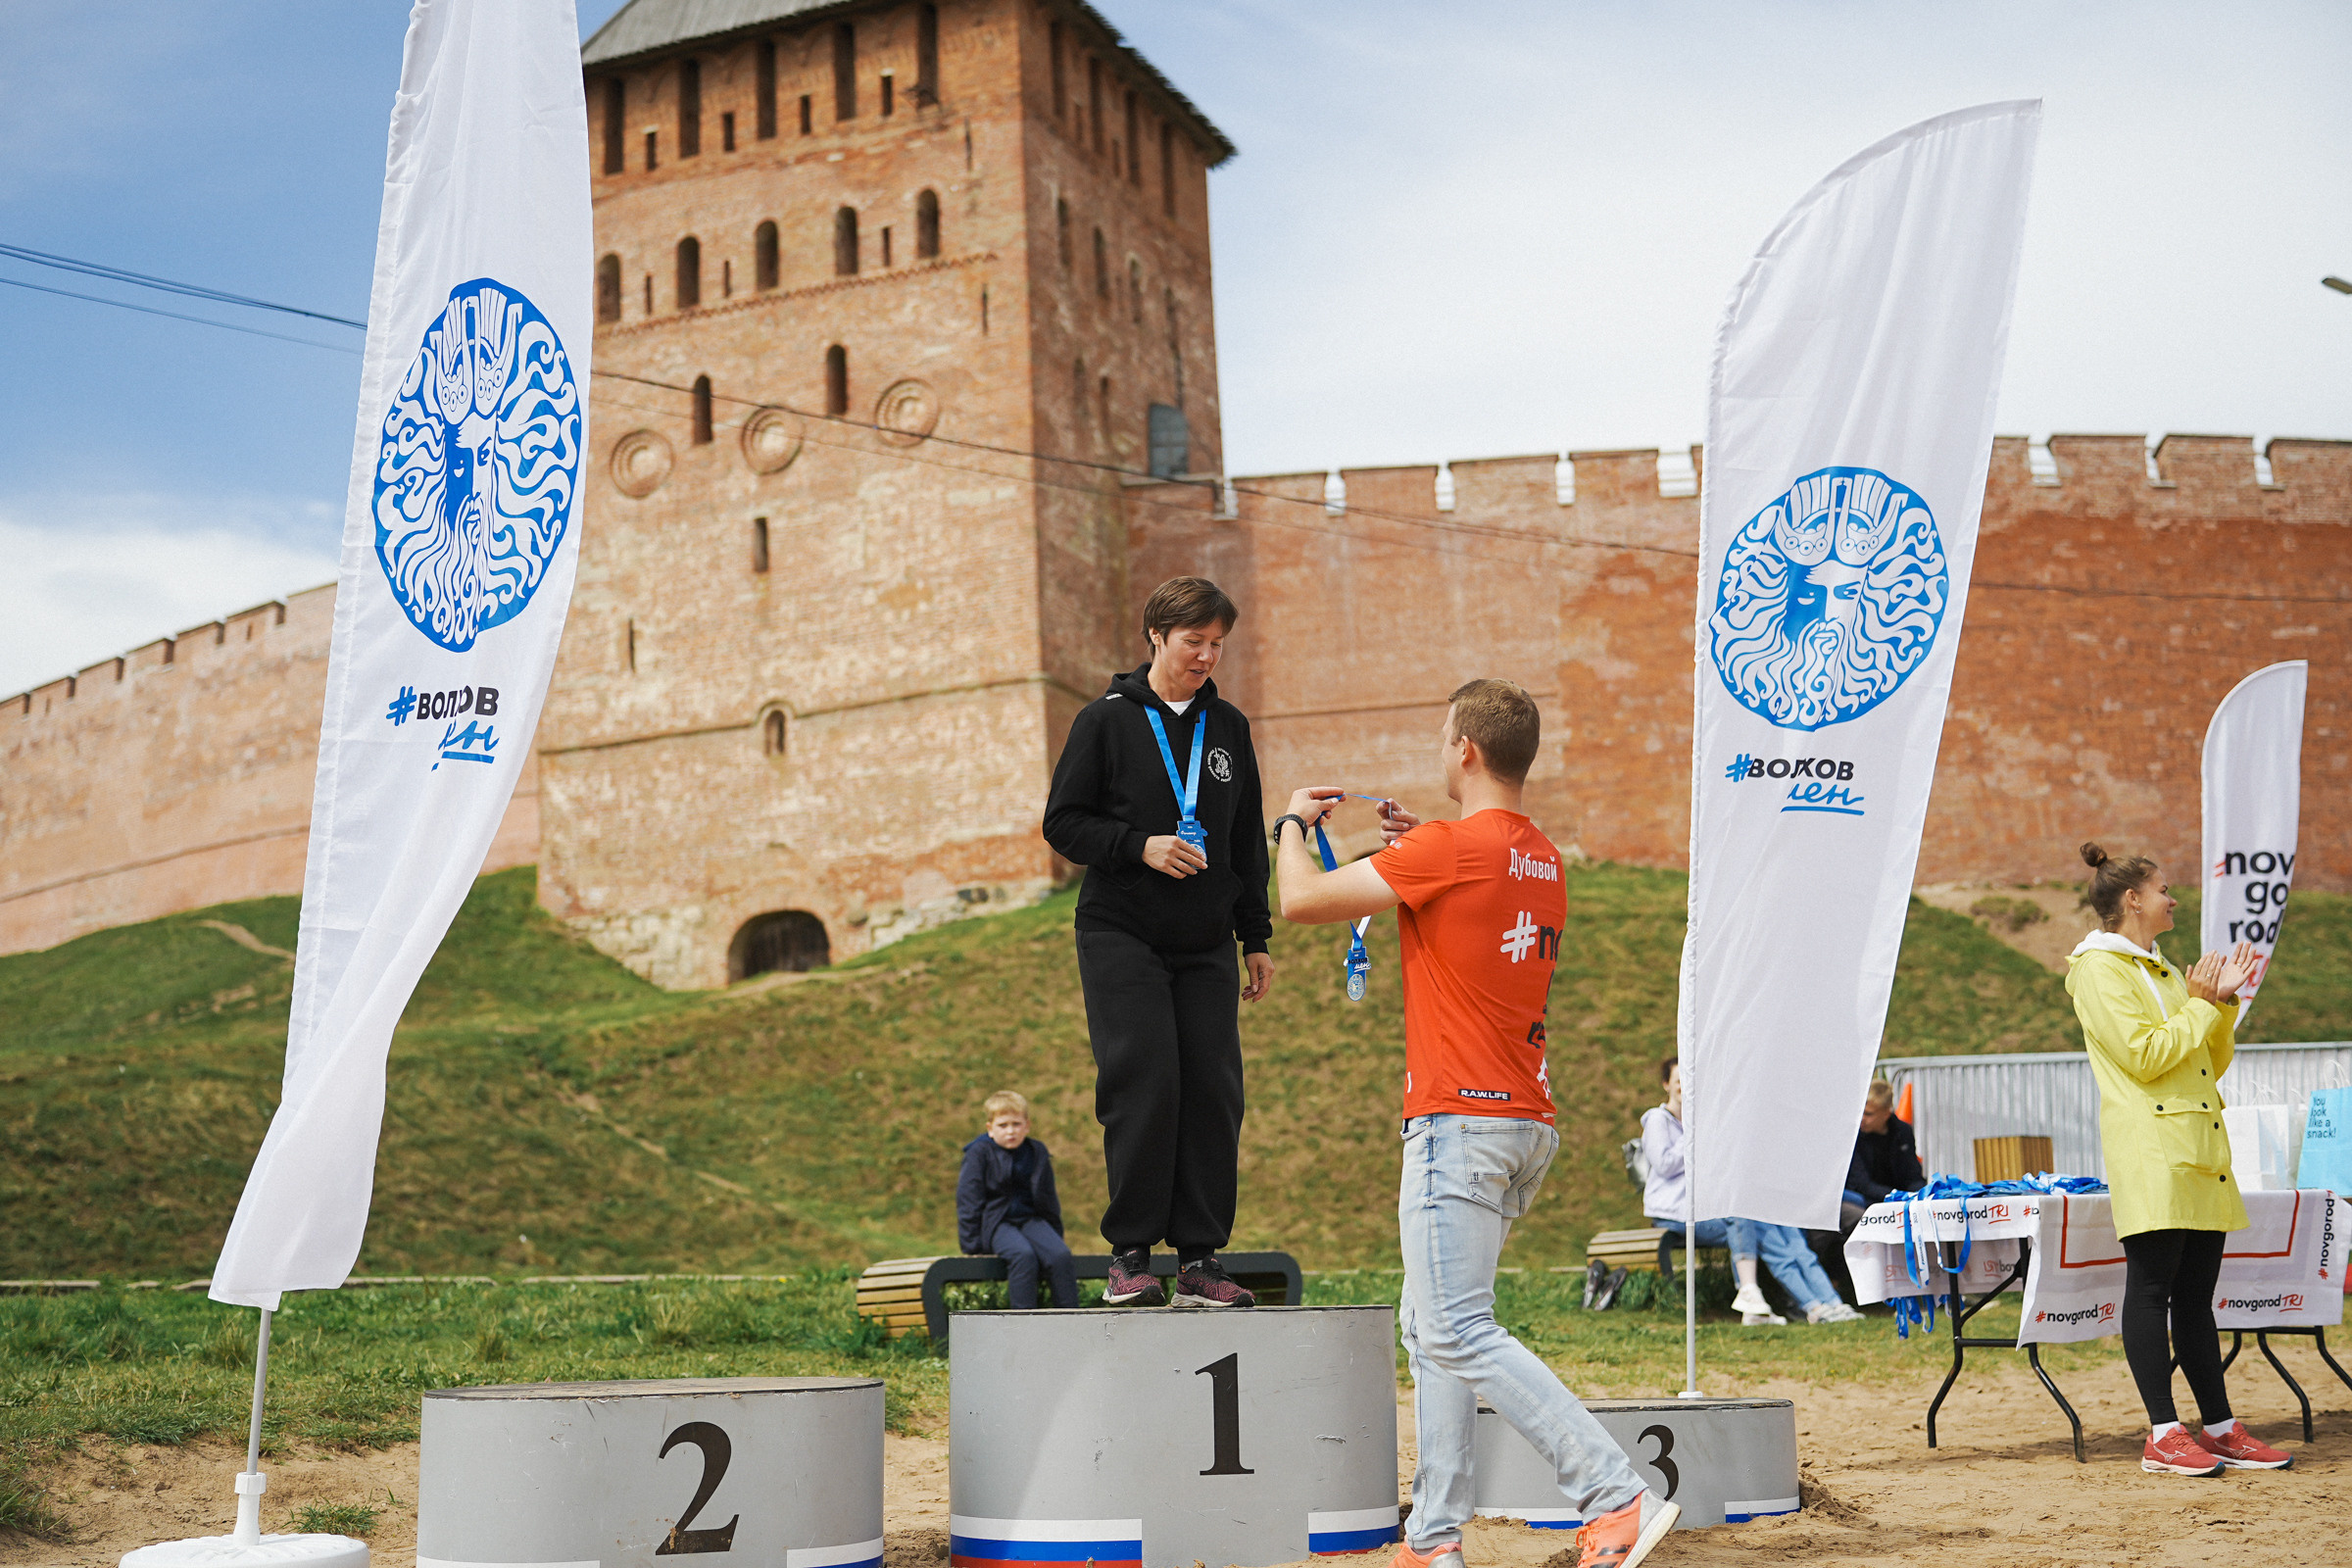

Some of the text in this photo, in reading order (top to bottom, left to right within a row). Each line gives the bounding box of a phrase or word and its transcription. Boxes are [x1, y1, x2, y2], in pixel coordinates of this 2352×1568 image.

[1509, 848, 1557, 882] Дубовой
[2245, 881, 2288, 914] go
[2307, 1127, 2336, 1139] snack!
[2218, 1294, 2304, 1312] #novgorodTRI
[1194, 1352, 1254, 1476] 1
[1638, 1424, 1680, 1501] 3
[655, 1421, 740, 1556] 2
